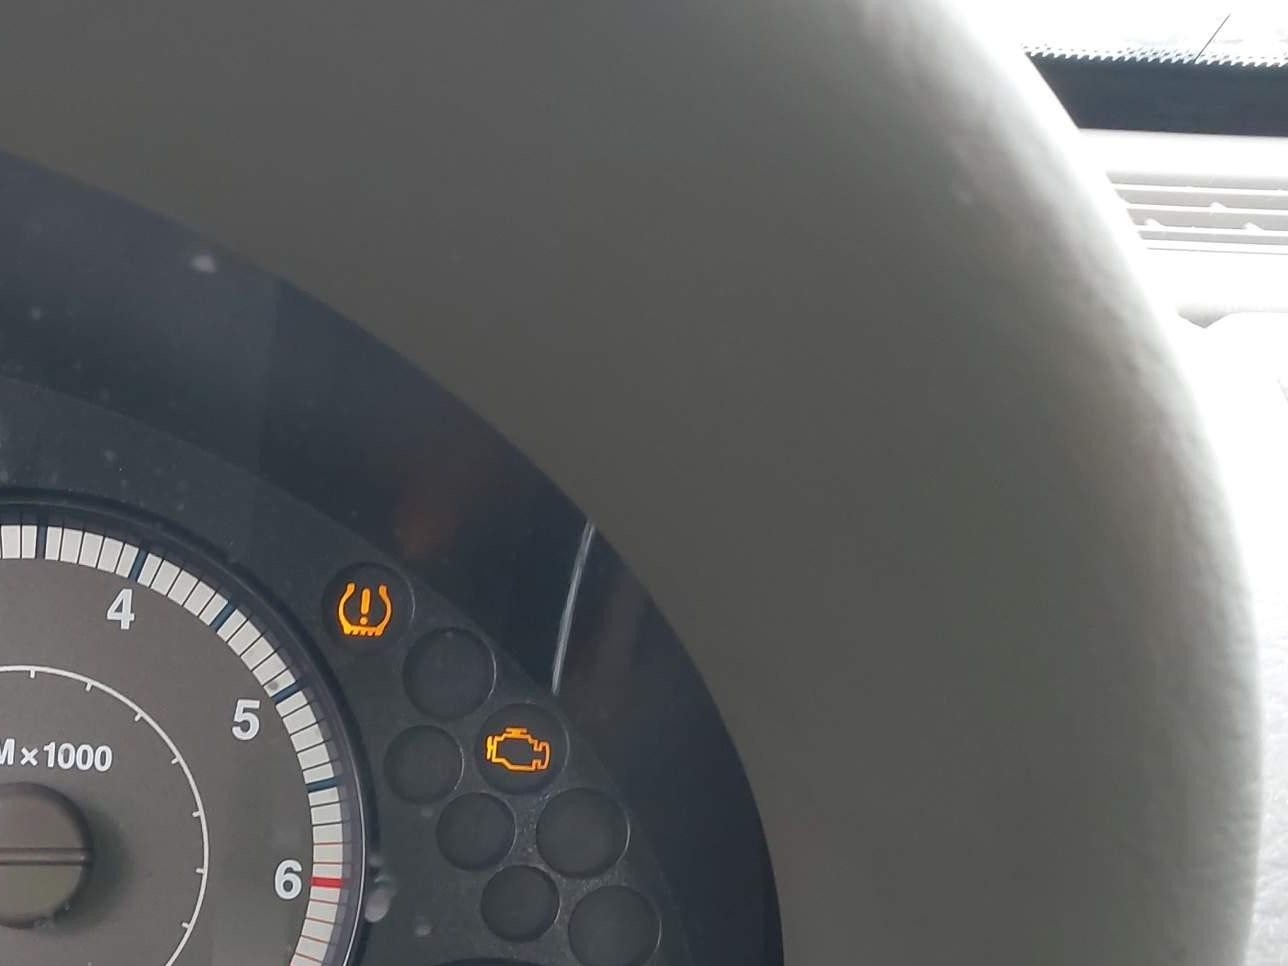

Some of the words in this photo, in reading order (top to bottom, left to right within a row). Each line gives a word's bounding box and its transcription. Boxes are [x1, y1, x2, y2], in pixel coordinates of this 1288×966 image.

[107, 589, 134, 629] 4
[233, 700, 260, 740] 5
[275, 860, 301, 899] 6
